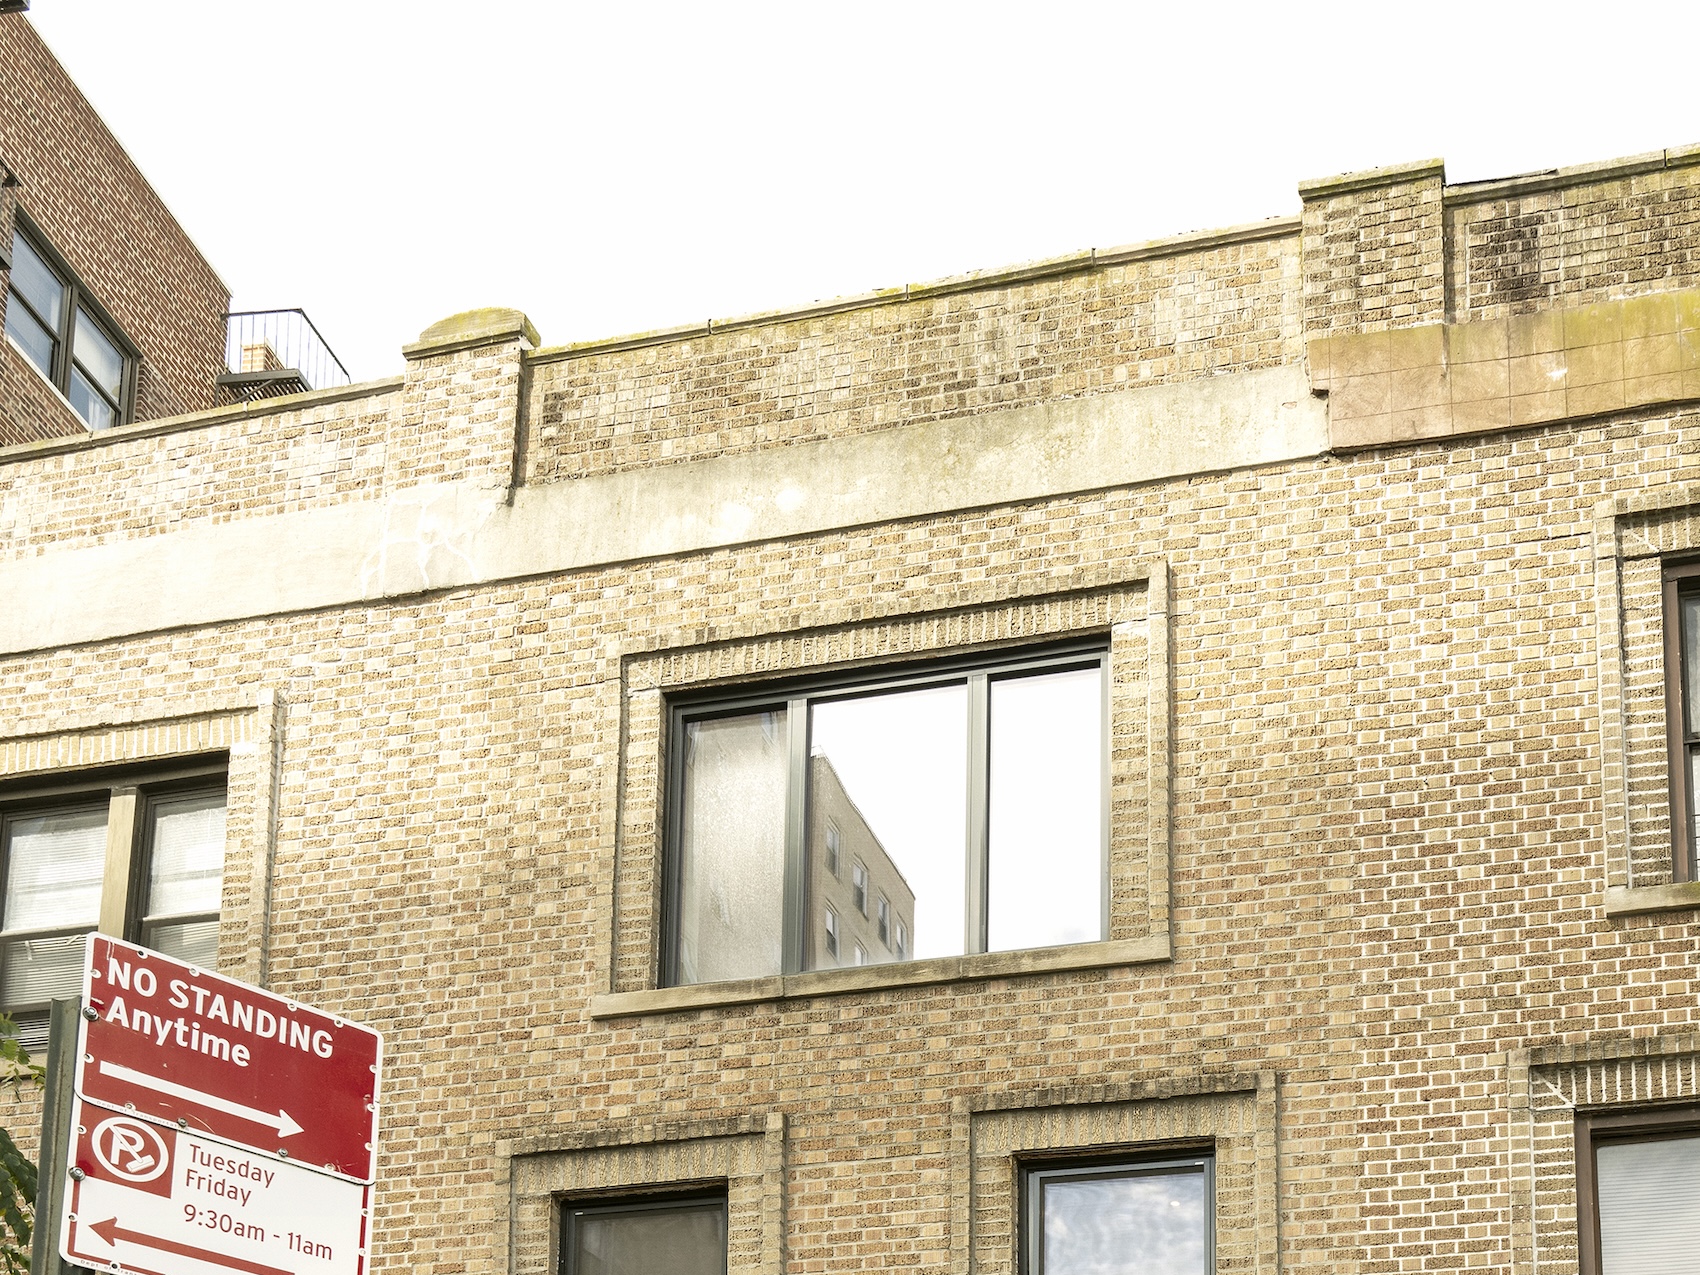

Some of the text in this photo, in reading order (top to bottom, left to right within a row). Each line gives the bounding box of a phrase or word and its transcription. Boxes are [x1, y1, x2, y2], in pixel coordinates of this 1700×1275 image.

[105, 996, 251, 1067] Anytime
[107, 958, 334, 1059] NO STANDING
[185, 1168, 252, 1207] Friday
[189, 1143, 275, 1189] Tuesday
[184, 1204, 265, 1242] 9:30am
[287, 1232, 333, 1261] 11am
